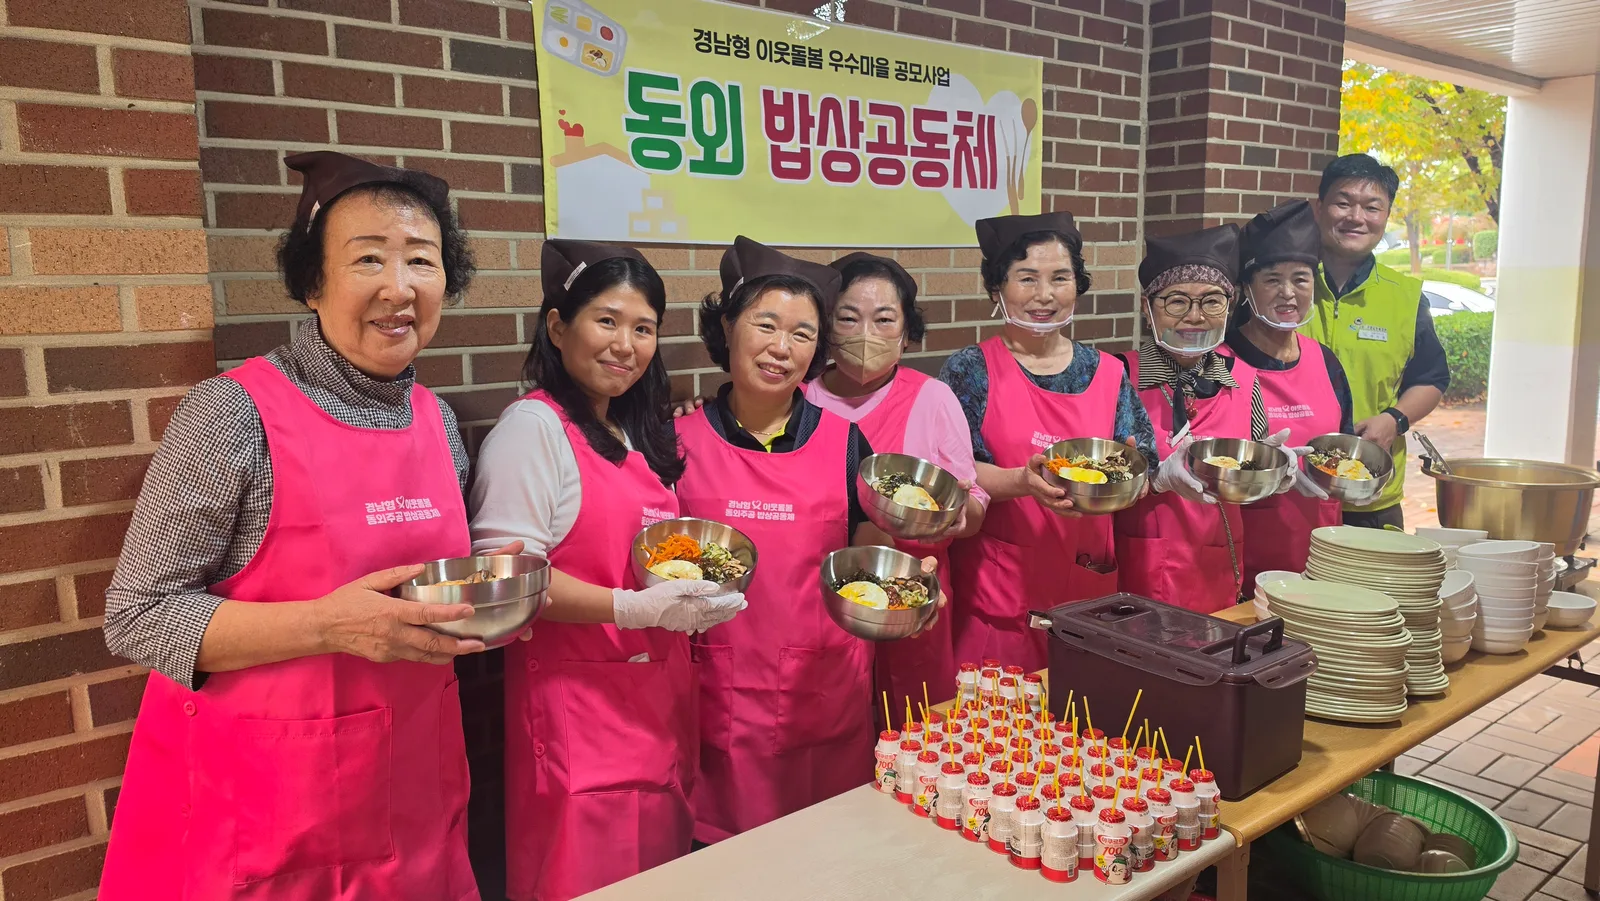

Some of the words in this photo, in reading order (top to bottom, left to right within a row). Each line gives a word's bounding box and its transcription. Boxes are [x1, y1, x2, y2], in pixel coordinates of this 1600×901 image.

[693, 28, 751, 59] 경남형
[755, 34, 823, 71] 이웃돌봄
[828, 48, 891, 79] 우수마을
[893, 59, 951, 88] 공모사업
[623, 69, 745, 177] 동외
[762, 88, 997, 191] 밥상공동체
[365, 500, 396, 513] 경남형
[405, 498, 433, 509] 이웃돌봄
[366, 511, 404, 526] 동외주공
[403, 508, 441, 522] 밥상공동체
